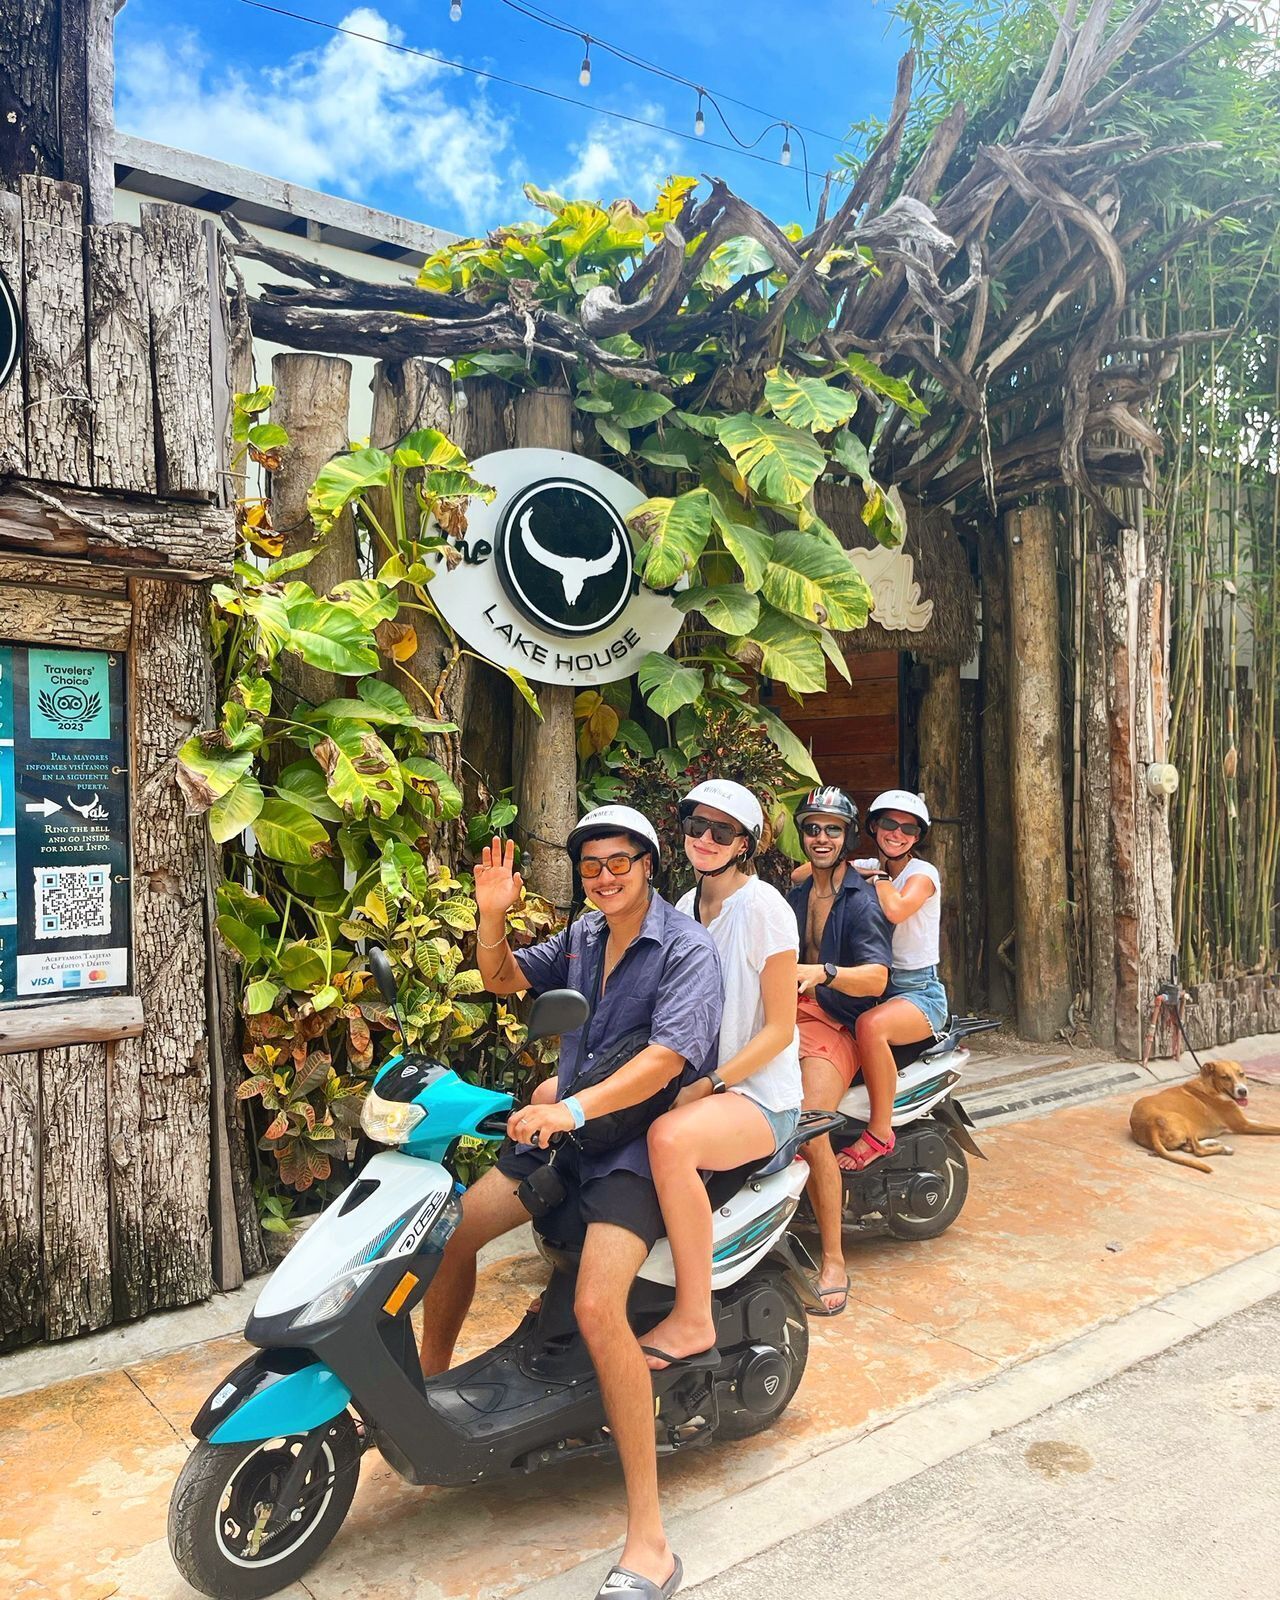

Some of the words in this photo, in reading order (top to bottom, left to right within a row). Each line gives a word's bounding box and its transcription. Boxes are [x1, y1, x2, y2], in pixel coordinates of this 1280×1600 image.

[482, 604, 549, 665] LAKE
[555, 627, 641, 672] HOUSE
[50, 675, 89, 686] Choice
[57, 722, 84, 731] 2023
[31, 977, 55, 987] VISA
